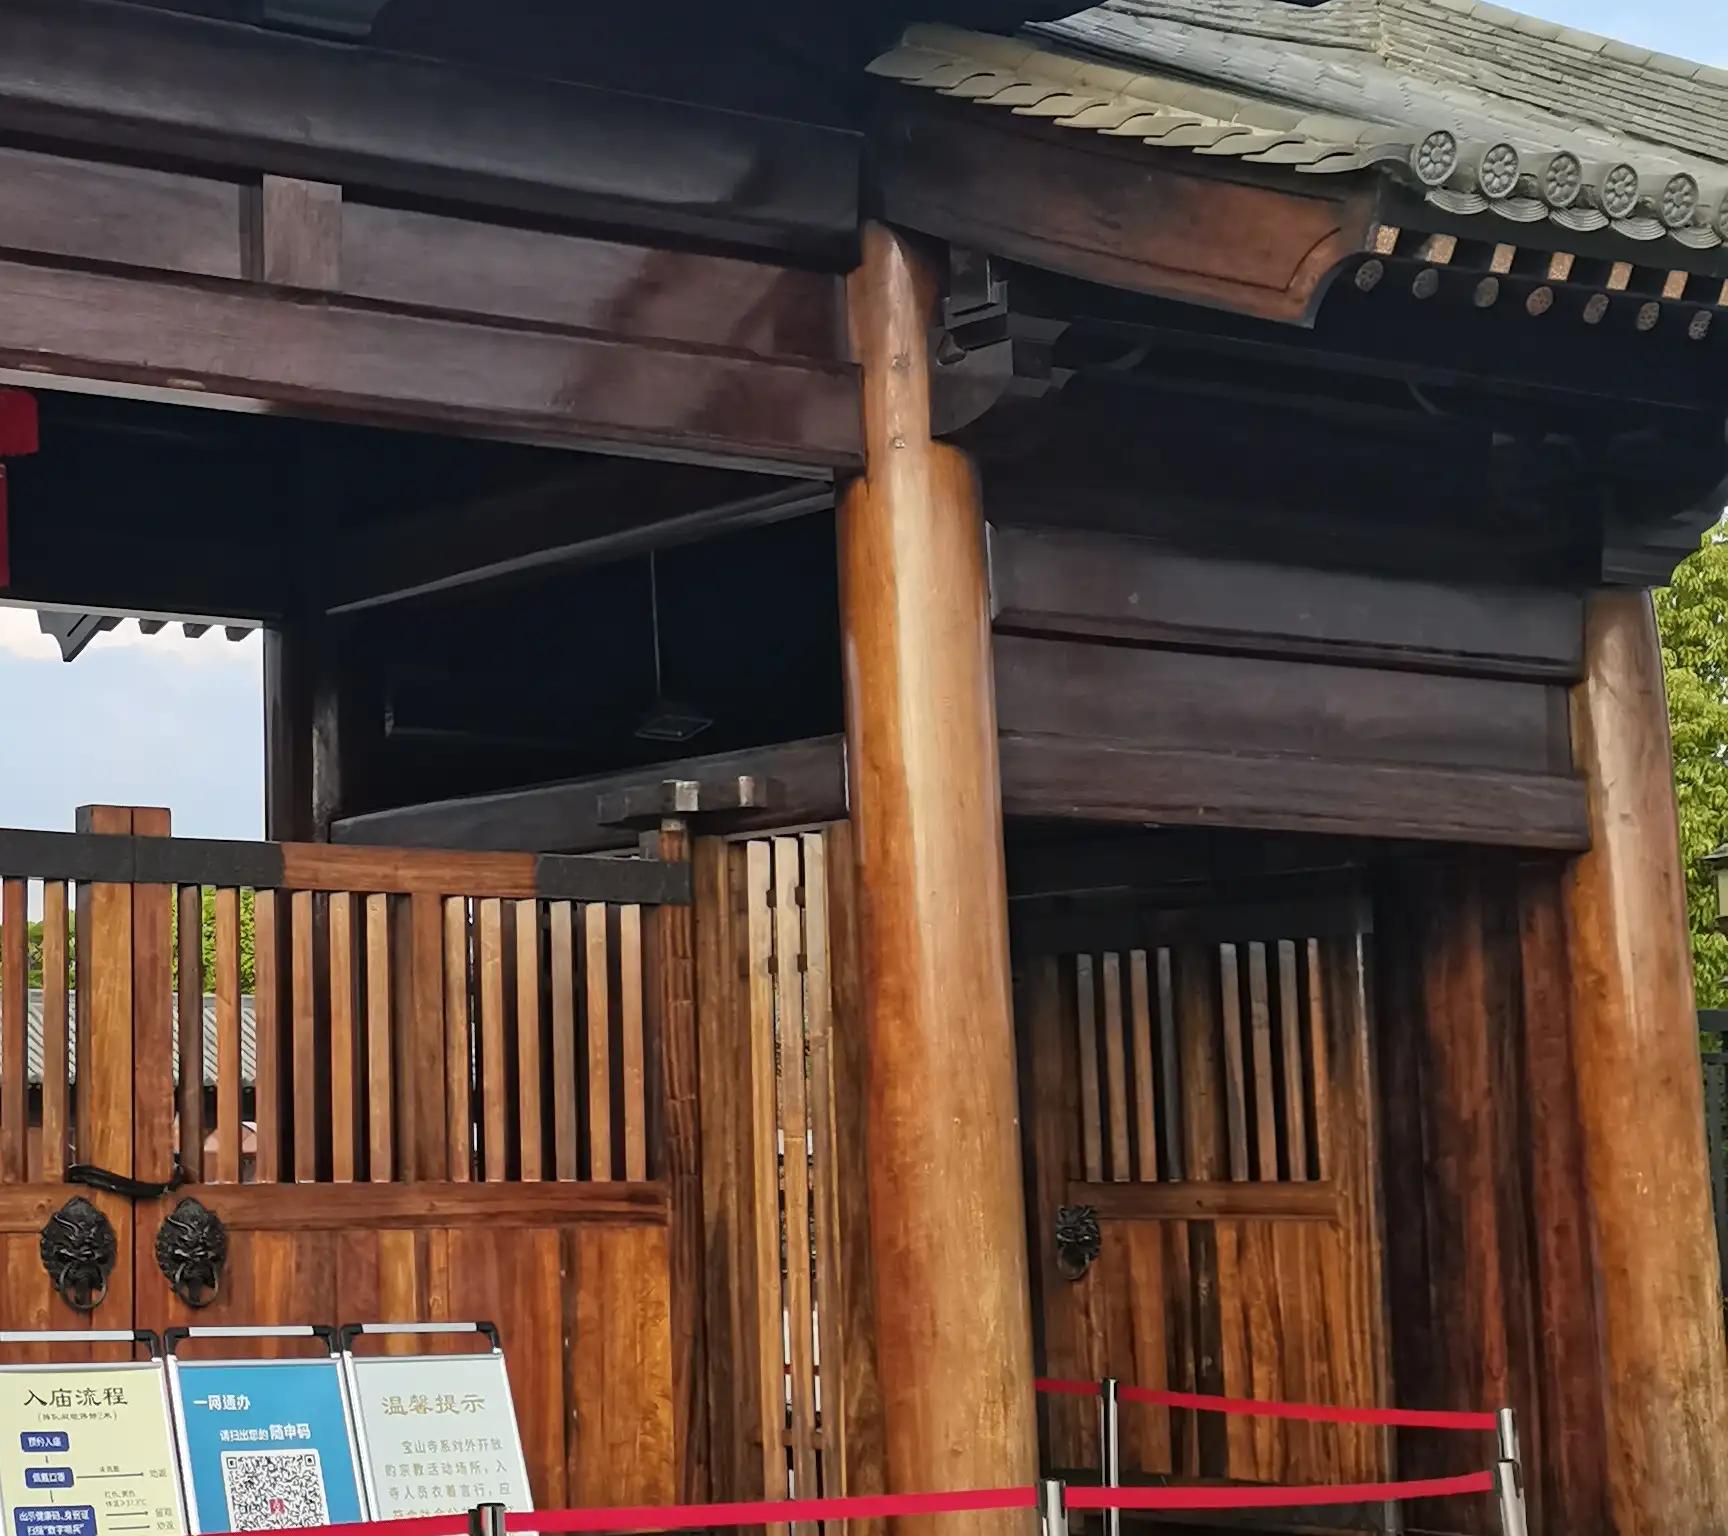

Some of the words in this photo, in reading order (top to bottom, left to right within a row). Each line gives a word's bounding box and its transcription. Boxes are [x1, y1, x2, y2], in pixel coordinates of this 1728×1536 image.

[23, 1387, 128, 1407] 入庙流程
[193, 1394, 251, 1411] 一网通办
[381, 1394, 485, 1415] 温馨提示
[401, 1438, 503, 1455] 宝山寺系对外开放
